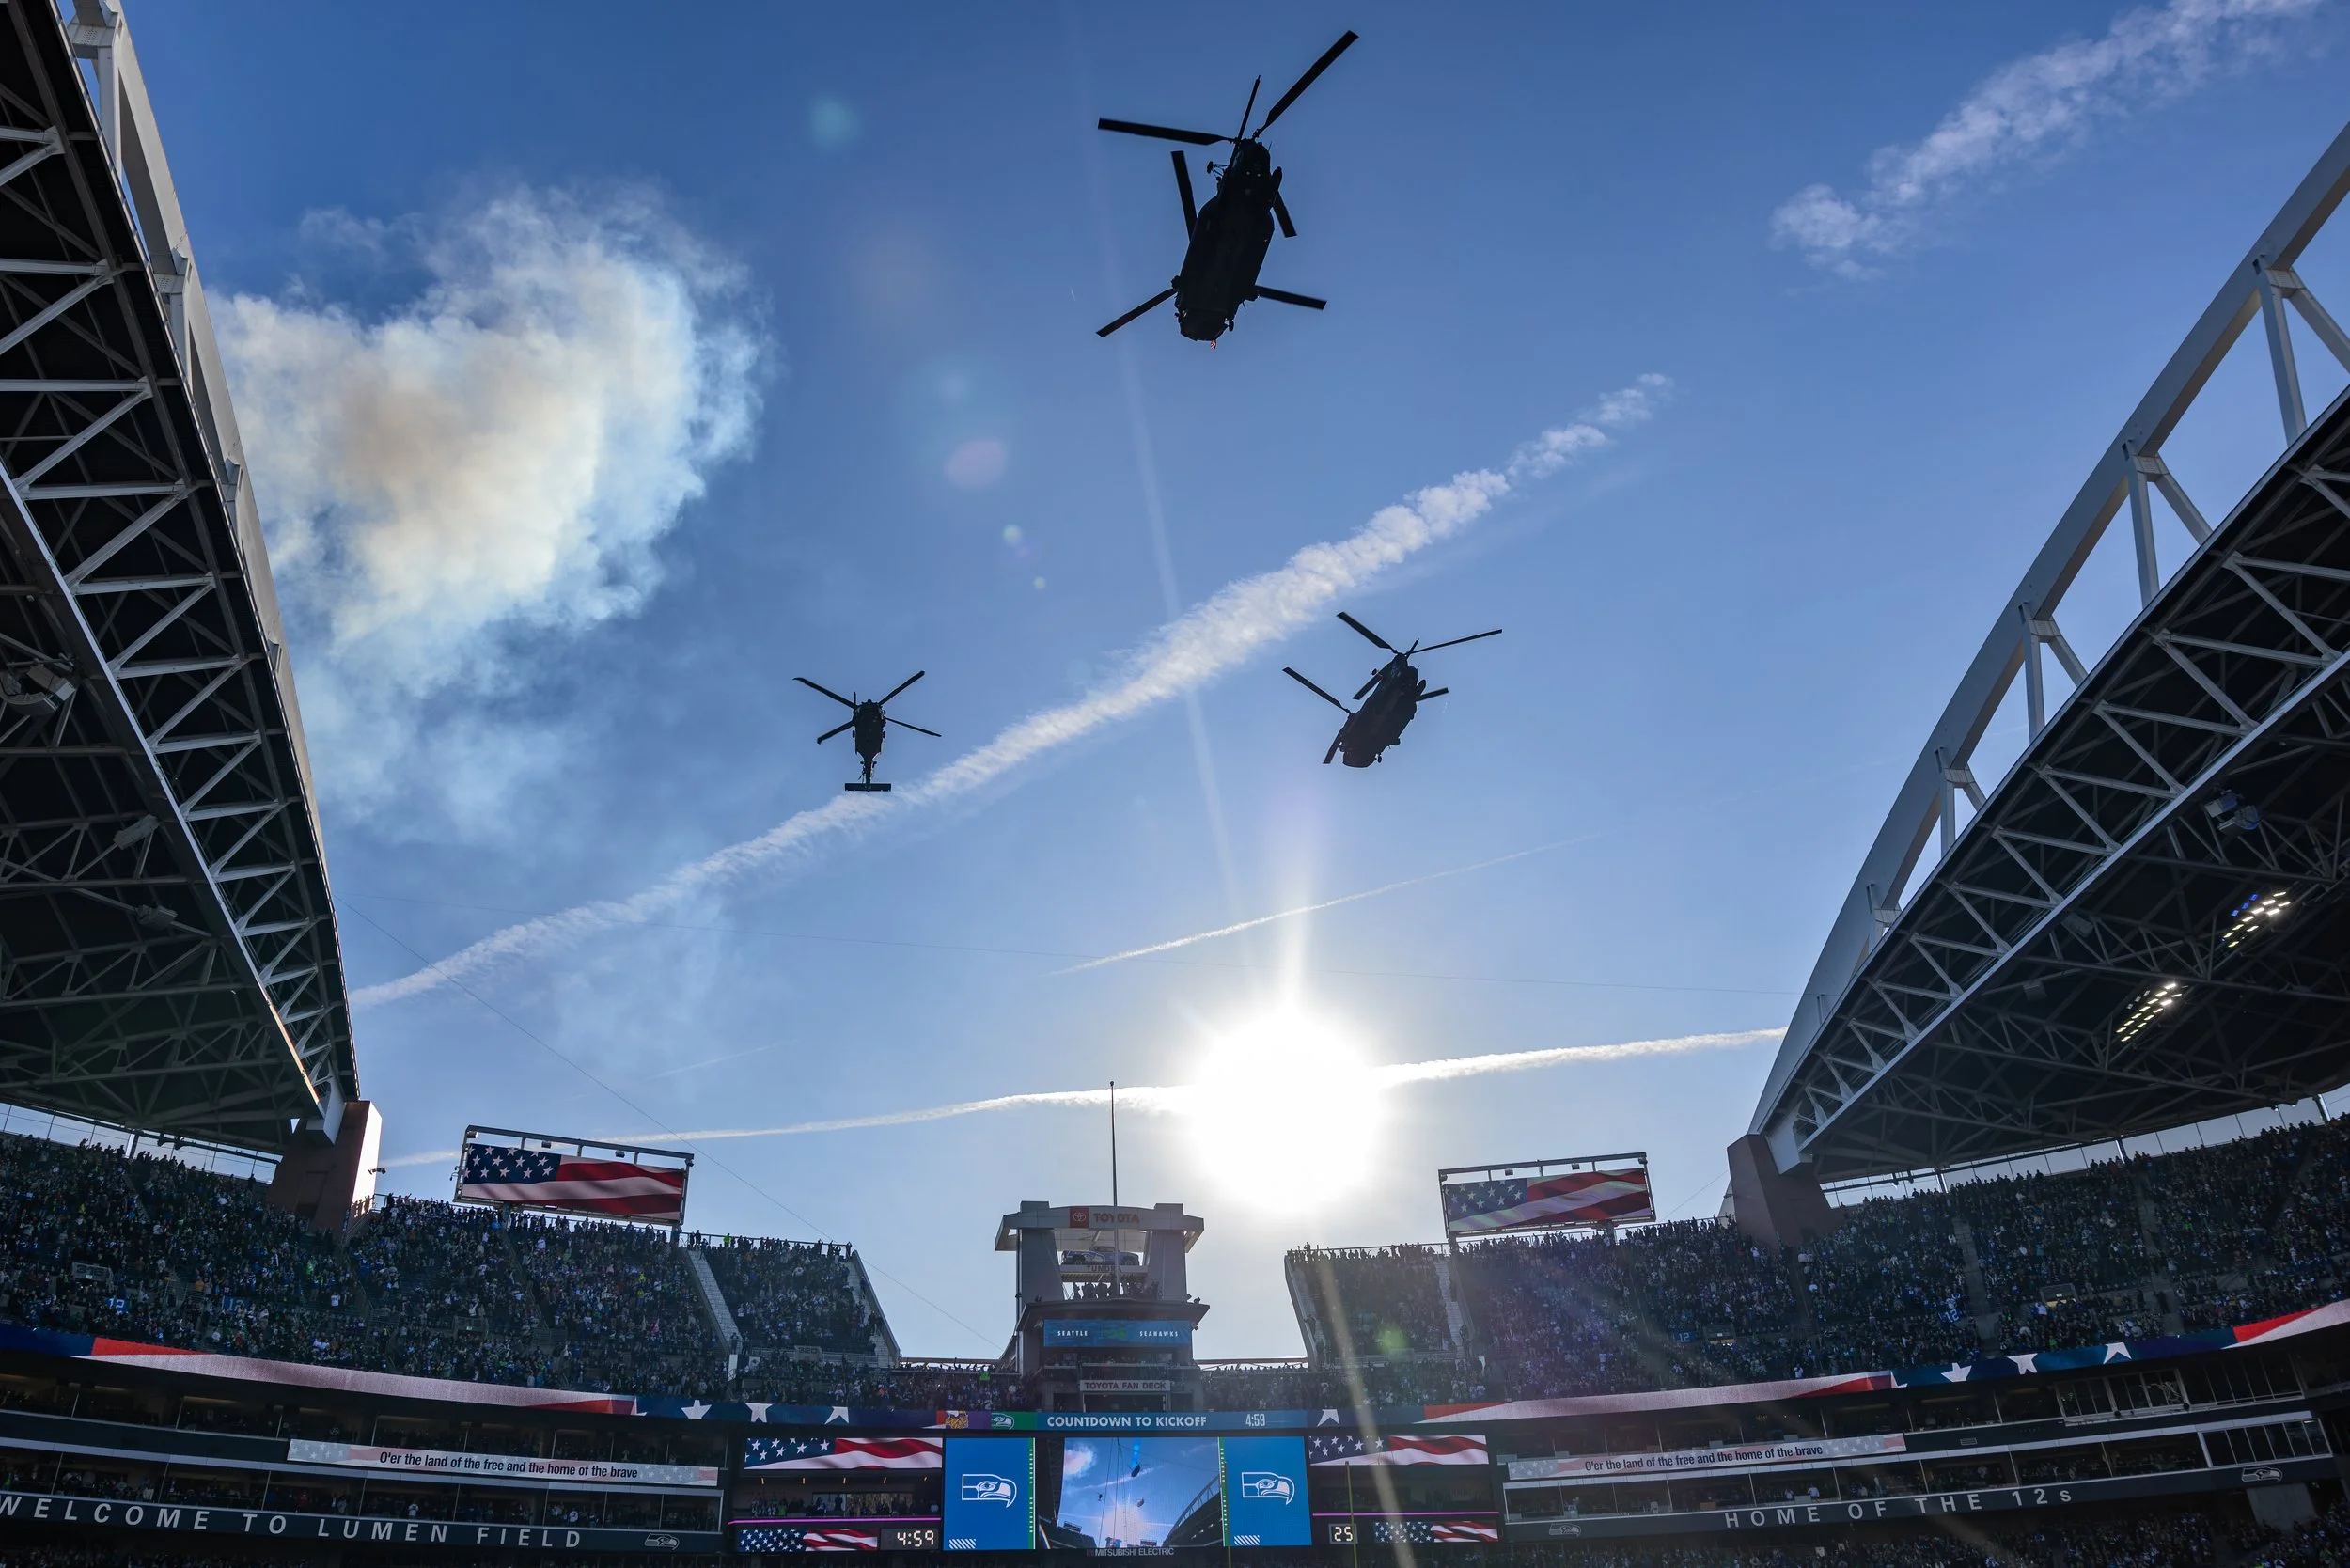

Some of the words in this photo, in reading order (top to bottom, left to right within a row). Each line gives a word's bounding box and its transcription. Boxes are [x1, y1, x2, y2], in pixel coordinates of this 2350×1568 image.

[1093, 1213, 1140, 1223] TOYOTA
[1678, 1332, 1690, 1343] 12
[1047, 1416, 1131, 1428] COUNTDOWN
[1136, 1416, 1152, 1428] TO
[1156, 1416, 1207, 1427] KICKOFF
[1246, 1413, 1266, 1427] 4:59
[380, 1451, 402, 1464] O'er
[404, 1453, 422, 1466] the
[424, 1454, 448, 1467] land
[451, 1457, 462, 1468] of
[464, 1457, 481, 1469] the
[483, 1459, 504, 1471] free
[507, 1462, 526, 1472] and
[528, 1462, 545, 1473] the
[547, 1464, 576, 1475] home
[578, 1465, 589, 1476] of
[591, 1466, 608, 1477] the
[610, 1467, 638, 1479] brave
[1585, 1461, 1604, 1471] O'er
[1606, 1460, 1622, 1470] the
[1623, 1458, 1644, 1469] land
[1646, 1457, 1656, 1467] of
[1657, 1456, 1674, 1466] the
[1675, 1454, 1695, 1466] free
[1697, 1452, 1716, 1464] and
[1717, 1451, 1733, 1462] the
[1735, 1450, 1762, 1461] home
[1765, 1448, 1775, 1459] of
[1777, 1447, 1794, 1458] the
[1795, 1445, 1824, 1456] brave
[1725, 1506, 1821, 1529] HOME
[1848, 1501, 1887, 1520] OF
[1915, 1493, 1982, 1514] THE
[2012, 1487, 2073, 1506] 12s
[0, 1495, 210, 1530] WELCOME
[243, 1513, 288, 1534] TO
[318, 1518, 447, 1543] LUMEN
[477, 1527, 581, 1548] FIELD
[896, 1529, 934, 1548] 4:59
[1333, 1526, 1354, 1542] 25
[1138, 1547, 1175, 1556] ELECTRIC
